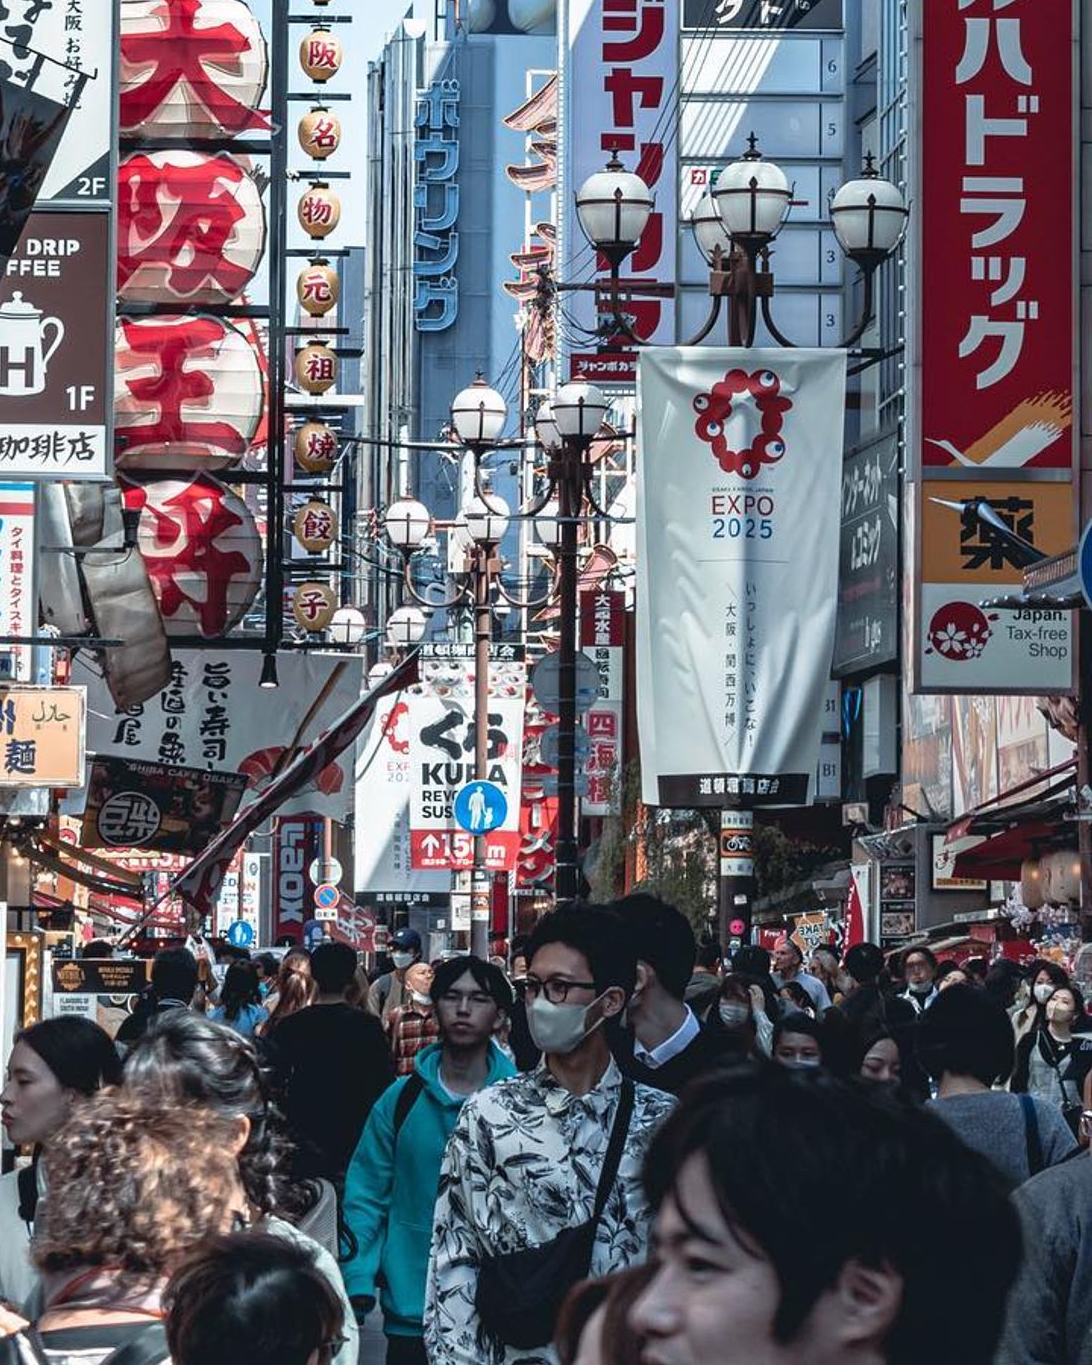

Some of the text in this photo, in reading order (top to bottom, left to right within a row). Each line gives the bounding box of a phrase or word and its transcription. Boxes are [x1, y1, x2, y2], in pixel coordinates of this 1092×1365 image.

[828, 60, 837, 73] 6
[828, 123, 837, 135] 5
[77, 177, 106, 195] 2F
[413, 79, 459, 332] ボウリング
[27, 239, 81, 255] DRIP
[826, 250, 835, 263] 3
[826, 313, 835, 327] 3
[66, 386, 95, 410] 1F
[712, 495, 774, 516] EXPO
[713, 518, 773, 539] 2025
[1008, 625, 1068, 641] Tax-free
[1029, 643, 1068, 659] Shop
[198, 662, 231, 769] 旨い寿司
[823, 763, 836, 777] B1
